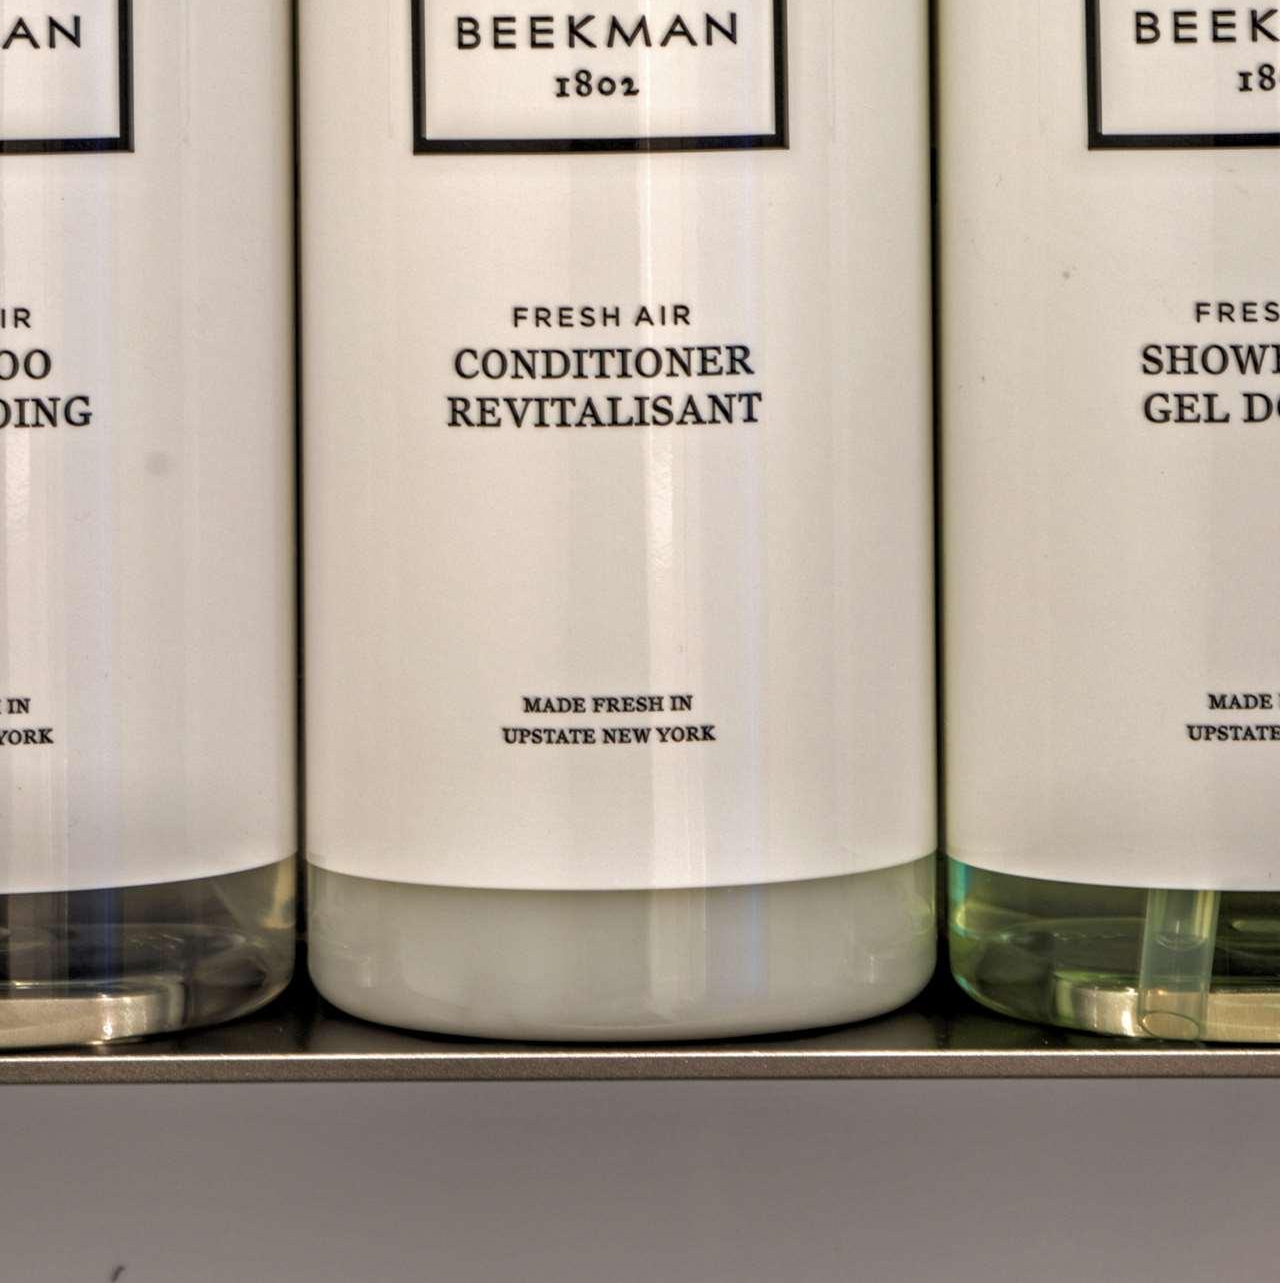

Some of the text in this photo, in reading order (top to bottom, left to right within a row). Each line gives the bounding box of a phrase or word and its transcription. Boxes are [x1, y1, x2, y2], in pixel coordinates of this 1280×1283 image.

[456, 11, 738, 51] BEEKMAN
[554, 68, 640, 99] 1802
[512, 303, 691, 328] FRESH AIR
[453, 344, 756, 380] CONDITIONER
[446, 391, 763, 429] REVITALISANT
[1142, 391, 1231, 424] GEL
[6, 697, 31, 715] IN
[522, 694, 694, 714] MADE FRESH IN
[1207, 693, 1274, 710] MADE
[501, 724, 717, 745] UPSTATE NEW YORK
